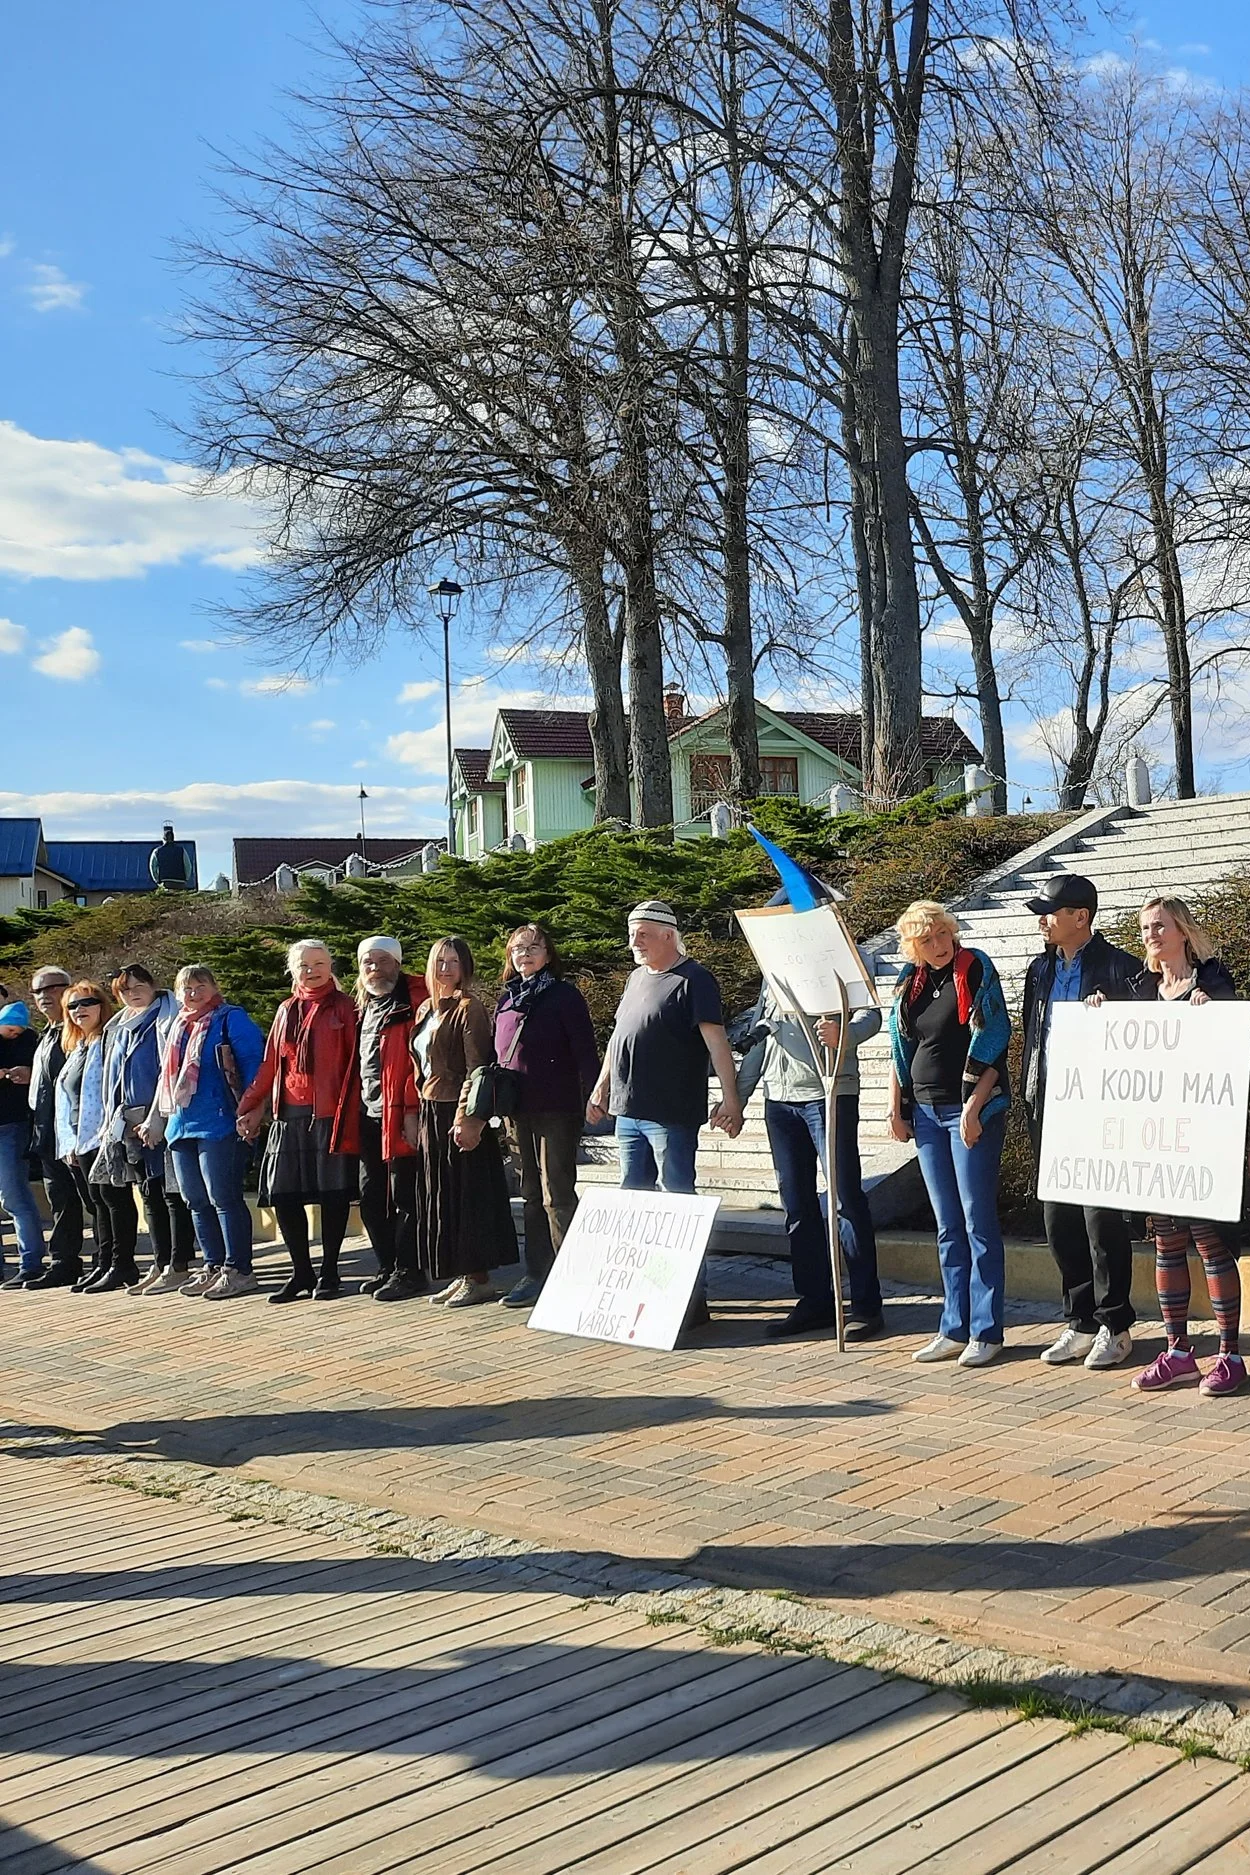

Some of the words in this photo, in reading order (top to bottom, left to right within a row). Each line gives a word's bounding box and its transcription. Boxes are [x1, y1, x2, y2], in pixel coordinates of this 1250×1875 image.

[1104, 1018, 1182, 1051] KODU
[1055, 1067, 1084, 1101] JA
[1101, 1068, 1164, 1102] KODU
[1182, 1072, 1235, 1106] MAA
[1102, 1117, 1126, 1150] EI
[1141, 1117, 1192, 1153] OLE
[1046, 1156, 1214, 1201] ASENDATAVAD
[577, 1207, 705, 1252] KODUKAITSELIIT
[606, 1241, 649, 1269] VÕRU
[597, 1268, 634, 1290] VERI
[597, 1291, 616, 1311] EI
